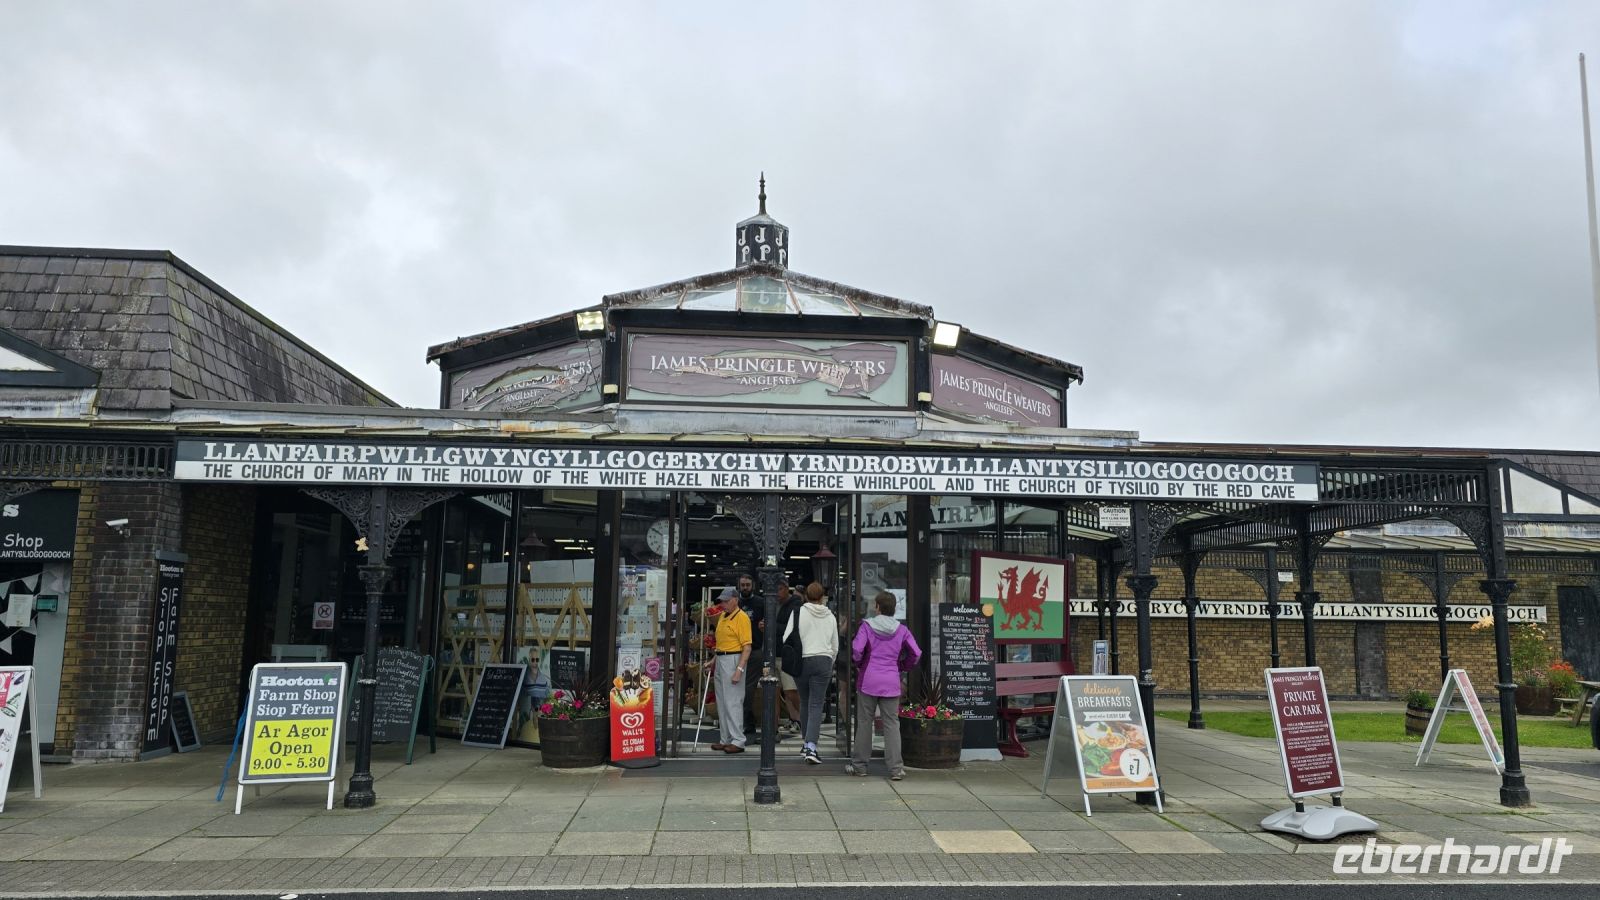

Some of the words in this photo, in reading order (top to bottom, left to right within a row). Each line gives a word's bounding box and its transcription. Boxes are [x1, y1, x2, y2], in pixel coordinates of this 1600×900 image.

[714, 357, 796, 373] PRINGLE
[939, 369, 970, 392] JAMES
[972, 380, 1012, 404] PRINGLE
[1013, 393, 1051, 417] WEAVERS
[203, 463, 232, 478] THE
[241, 464, 304, 480] CHURCH
[314, 465, 333, 480] OF
[343, 466, 389, 481] MARY
[397, 467, 412, 482] IN
[422, 468, 450, 482] THE
[460, 469, 523, 484] HOLLOW
[533, 470, 552, 484] OF
[561, 470, 589, 485] THE
[599, 471, 647, 486] WHITE
[655, 472, 702, 487] HAZEL
[711, 473, 750, 488] NEAR
[760, 473, 786, 488] THE
[797, 474, 844, 489] FIERCE
[854, 475, 936, 491] WHIRLPOOL
[945, 477, 975, 492] AND
[984, 477, 1010, 493] THE
[1018, 478, 1075, 494] CHURCH
[1085, 480, 1102, 494] OF
[1109, 480, 1160, 496] TYSILIO
[1168, 481, 1185, 496] BY
[1193, 482, 1219, 497] THE
[1227, 483, 1253, 498] RED
[1261, 484, 1295, 499] CAVE
[3, 533, 44, 551] Shop
[167, 587, 179, 647] Farm
[953, 604, 979, 614] welcome
[156, 587, 168, 654] Siop
[260, 675, 338, 687] Hooton's
[161, 661, 172, 725] Shop
[258, 689, 299, 701] Farm
[303, 688, 337, 702] Shop
[1083, 683, 1122, 696] delicious
[1283, 690, 1317, 702] PRIVATE
[147, 661, 162, 742] Fferm
[1077, 696, 1132, 708] BREAKFASTS
[256, 703, 287, 718] Siop
[290, 703, 335, 716] Fferm
[1283, 706, 1302, 717] CAR
[1302, 703, 1323, 716] PARK
[257, 724, 281, 739] Ar
[286, 724, 329, 740] Agor
[621, 728, 645, 736] WALL'S
[269, 741, 313, 757] Open
[252, 757, 282, 770] 9.00
[296, 756, 326, 769] 5.30
[1129, 758, 1140, 775] £7
